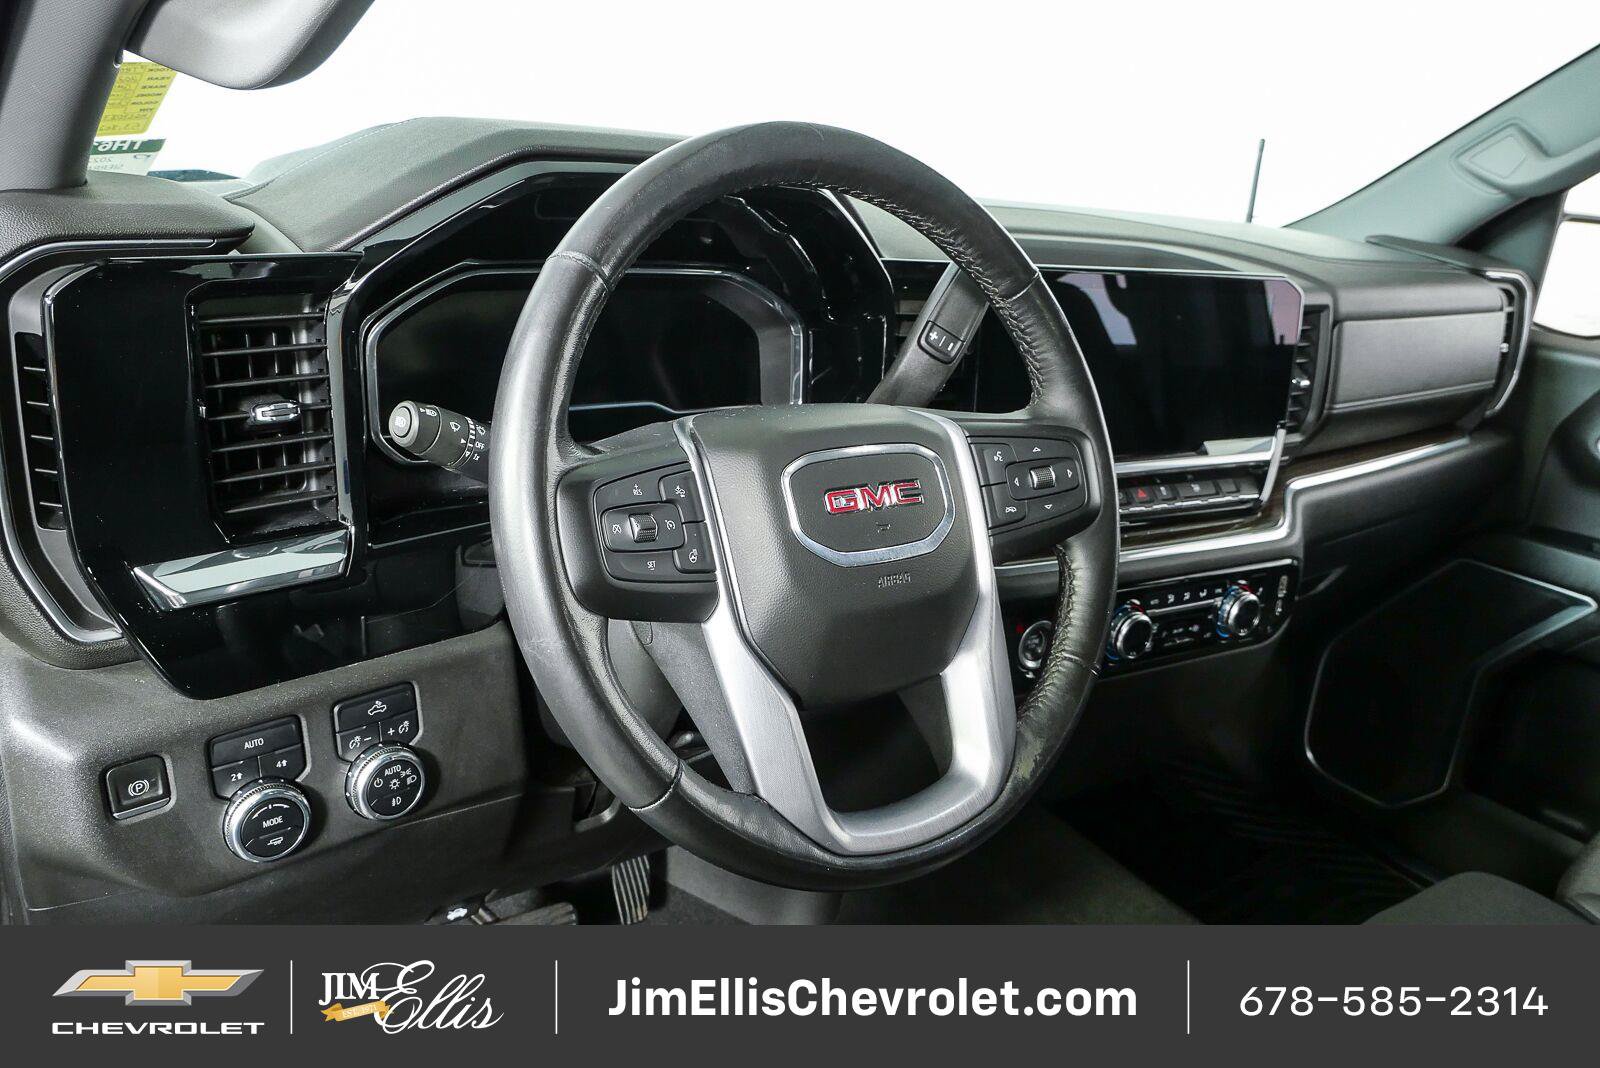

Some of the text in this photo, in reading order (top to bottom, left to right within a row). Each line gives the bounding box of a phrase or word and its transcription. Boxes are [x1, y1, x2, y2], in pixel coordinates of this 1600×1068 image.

[475, 441, 485, 450] OFF
[824, 480, 924, 515] GMC
[878, 572, 912, 588] AIRBAG
[243, 738, 265, 750] AUTO
[384, 764, 402, 776] AUTO
[262, 816, 284, 829] MODE
